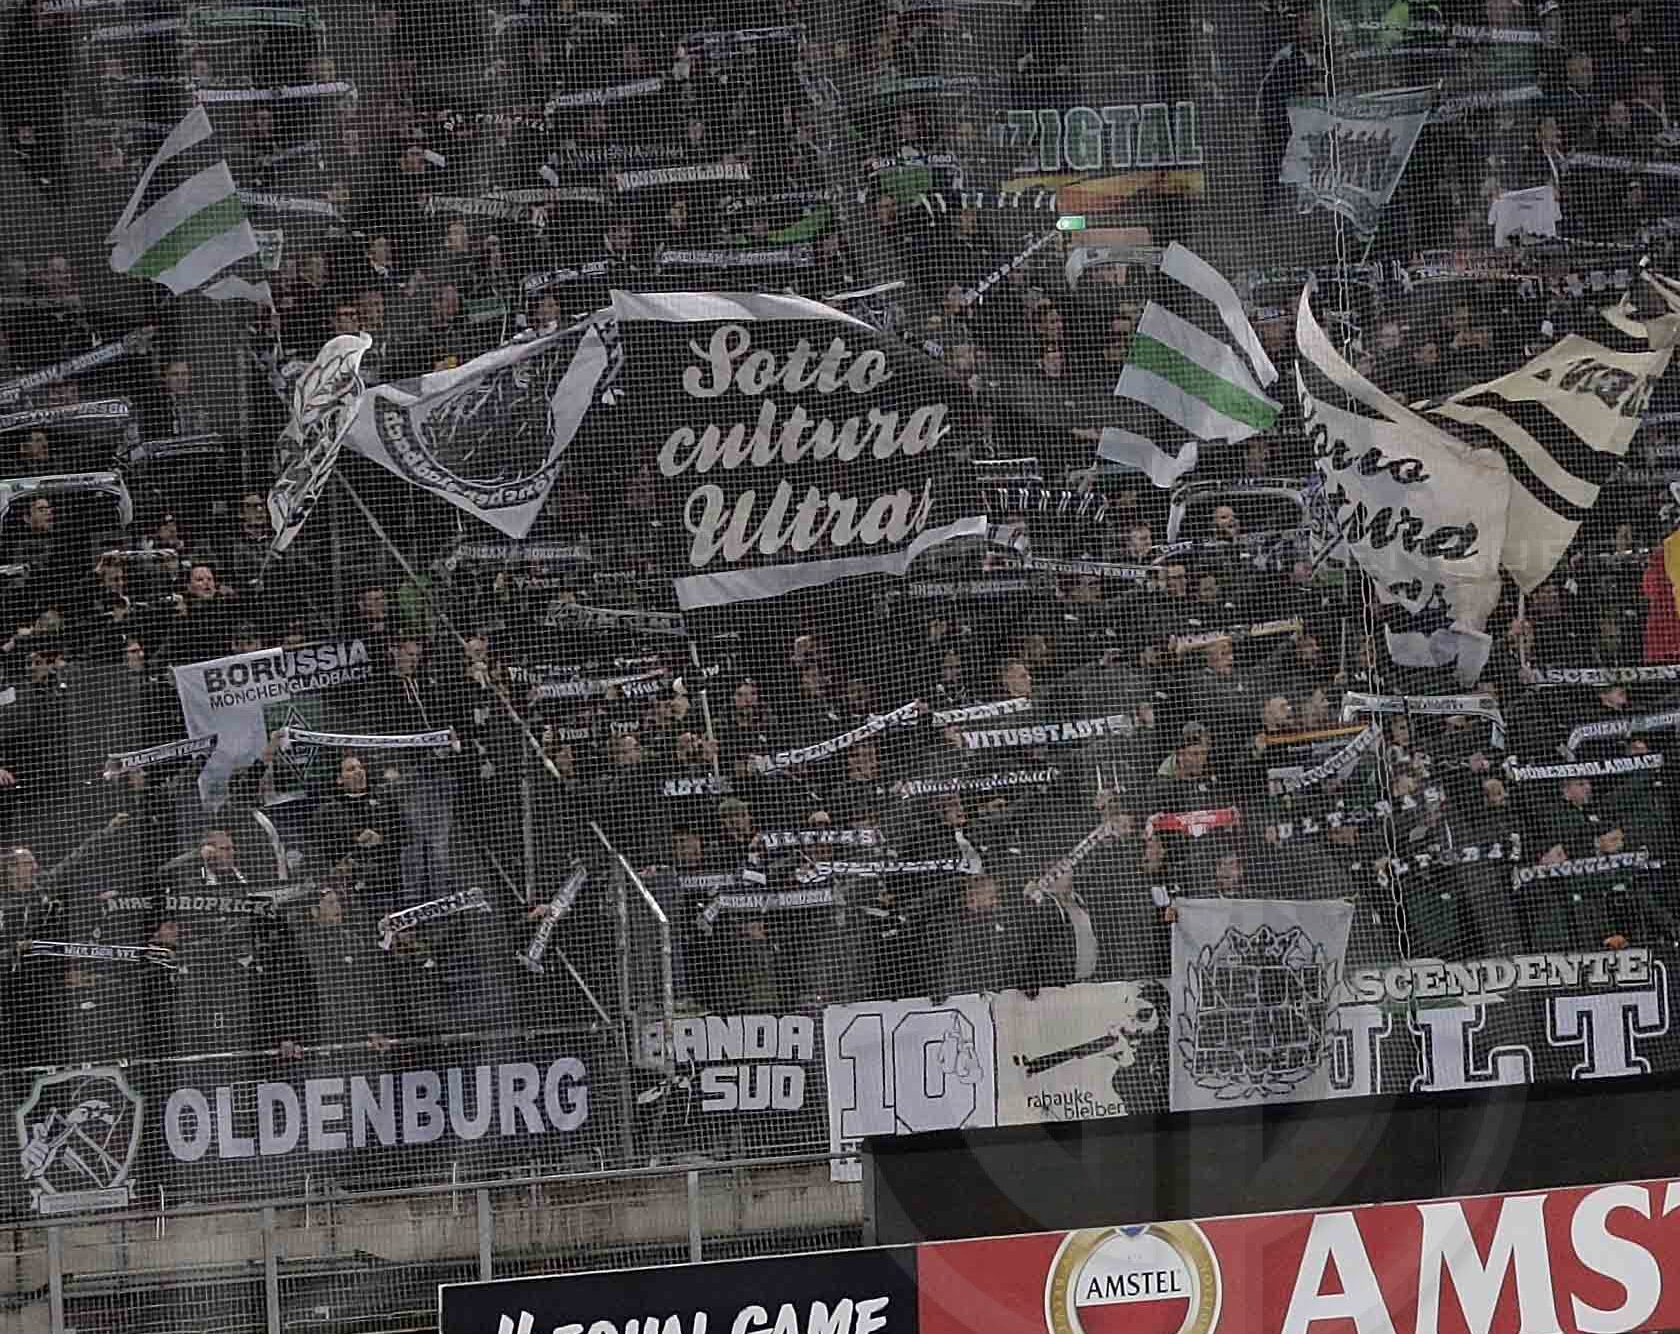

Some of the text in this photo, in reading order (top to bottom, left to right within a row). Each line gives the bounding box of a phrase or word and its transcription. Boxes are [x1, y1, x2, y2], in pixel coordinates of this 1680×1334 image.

[682, 324, 898, 398] Sotto
[655, 398, 953, 477] cultura
[202, 640, 370, 695] BORUSSIA
[162, 1057, 591, 1163] OLDENBURG
[1085, 1268, 1182, 1300] AMSTEL
